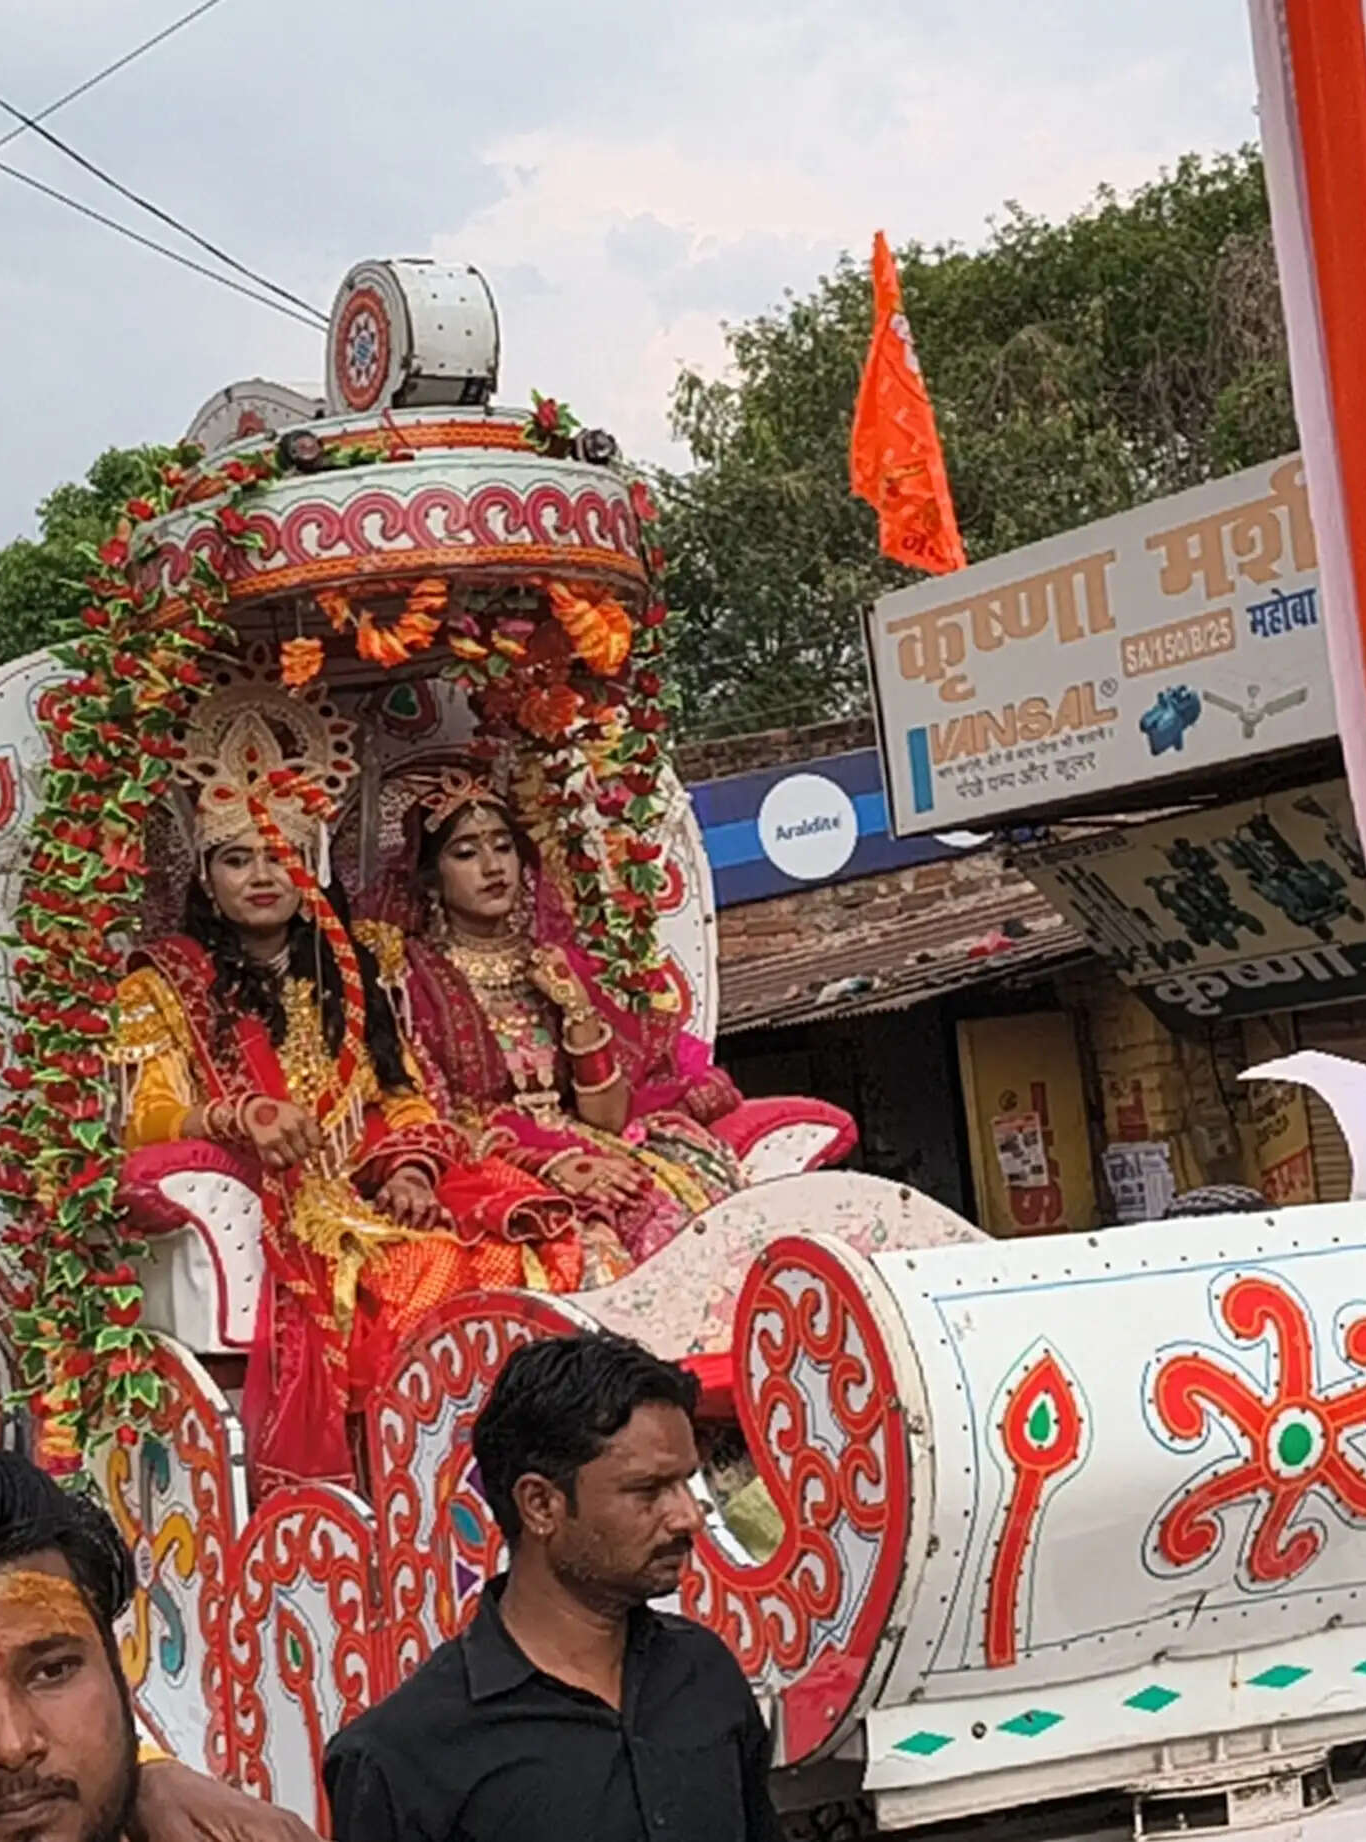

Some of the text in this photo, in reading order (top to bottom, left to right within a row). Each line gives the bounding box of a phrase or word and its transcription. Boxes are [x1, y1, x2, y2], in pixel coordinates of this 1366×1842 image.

[886, 551, 1116, 701] कृष्णा
[1245, 587, 1318, 638] महोबा
[929, 680, 1119, 766] VANSAL
[775, 813, 842, 842] Araldite
